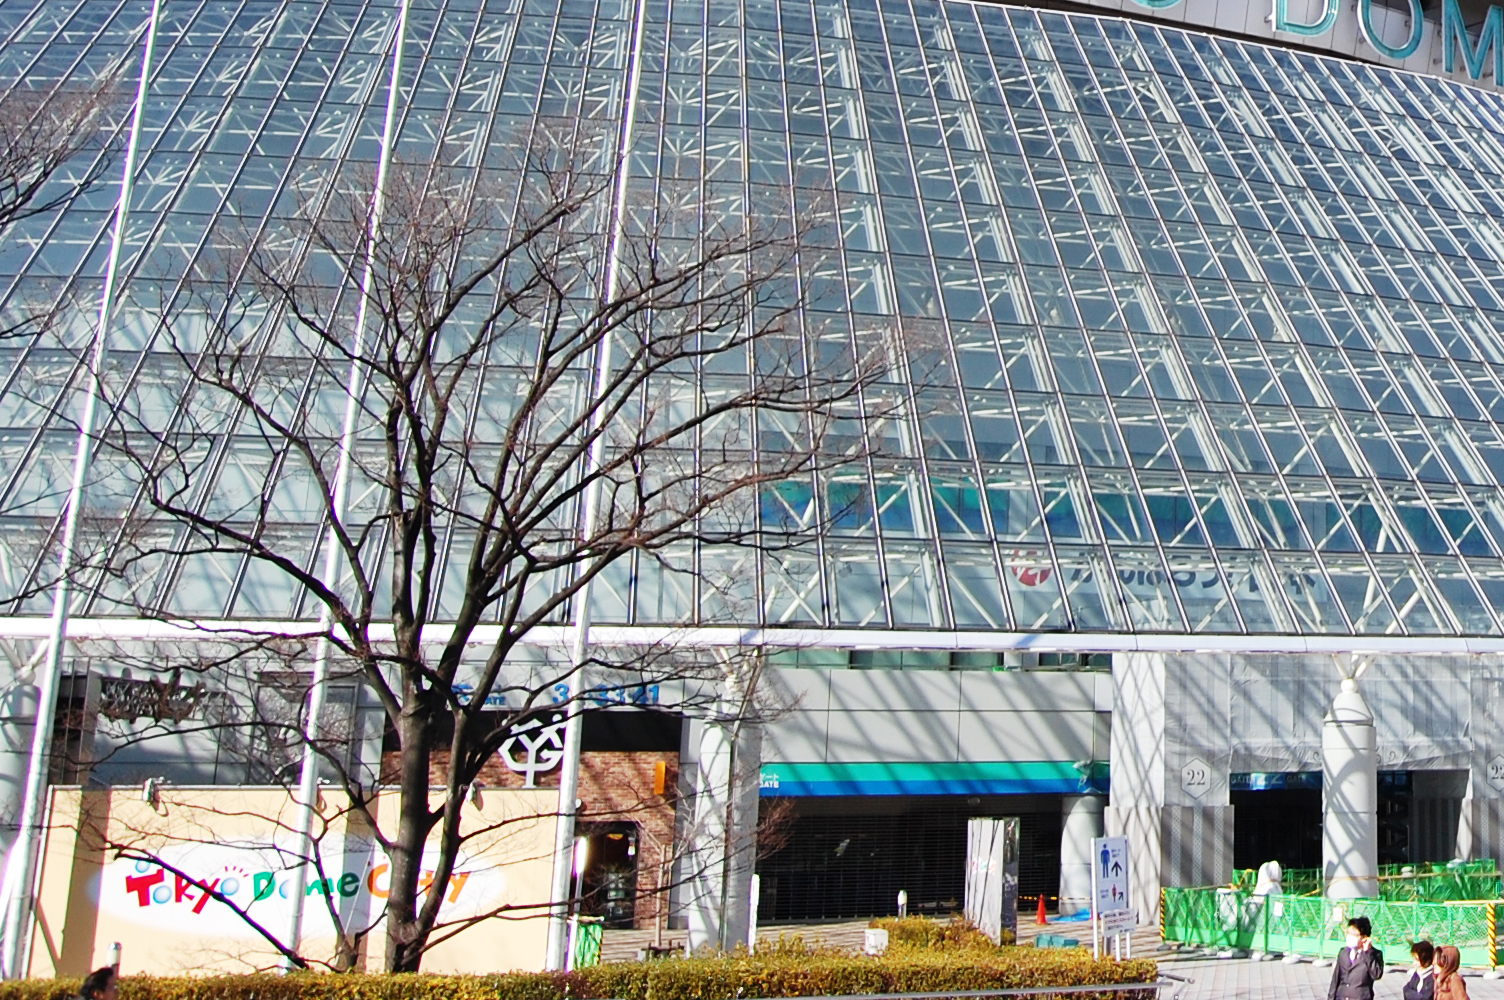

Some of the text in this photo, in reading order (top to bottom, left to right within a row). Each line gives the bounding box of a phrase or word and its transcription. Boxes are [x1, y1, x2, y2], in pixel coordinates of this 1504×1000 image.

[484, 696, 507, 706] ATE
[1187, 769, 1206, 786] 22
[368, 860, 470, 904] Cty
